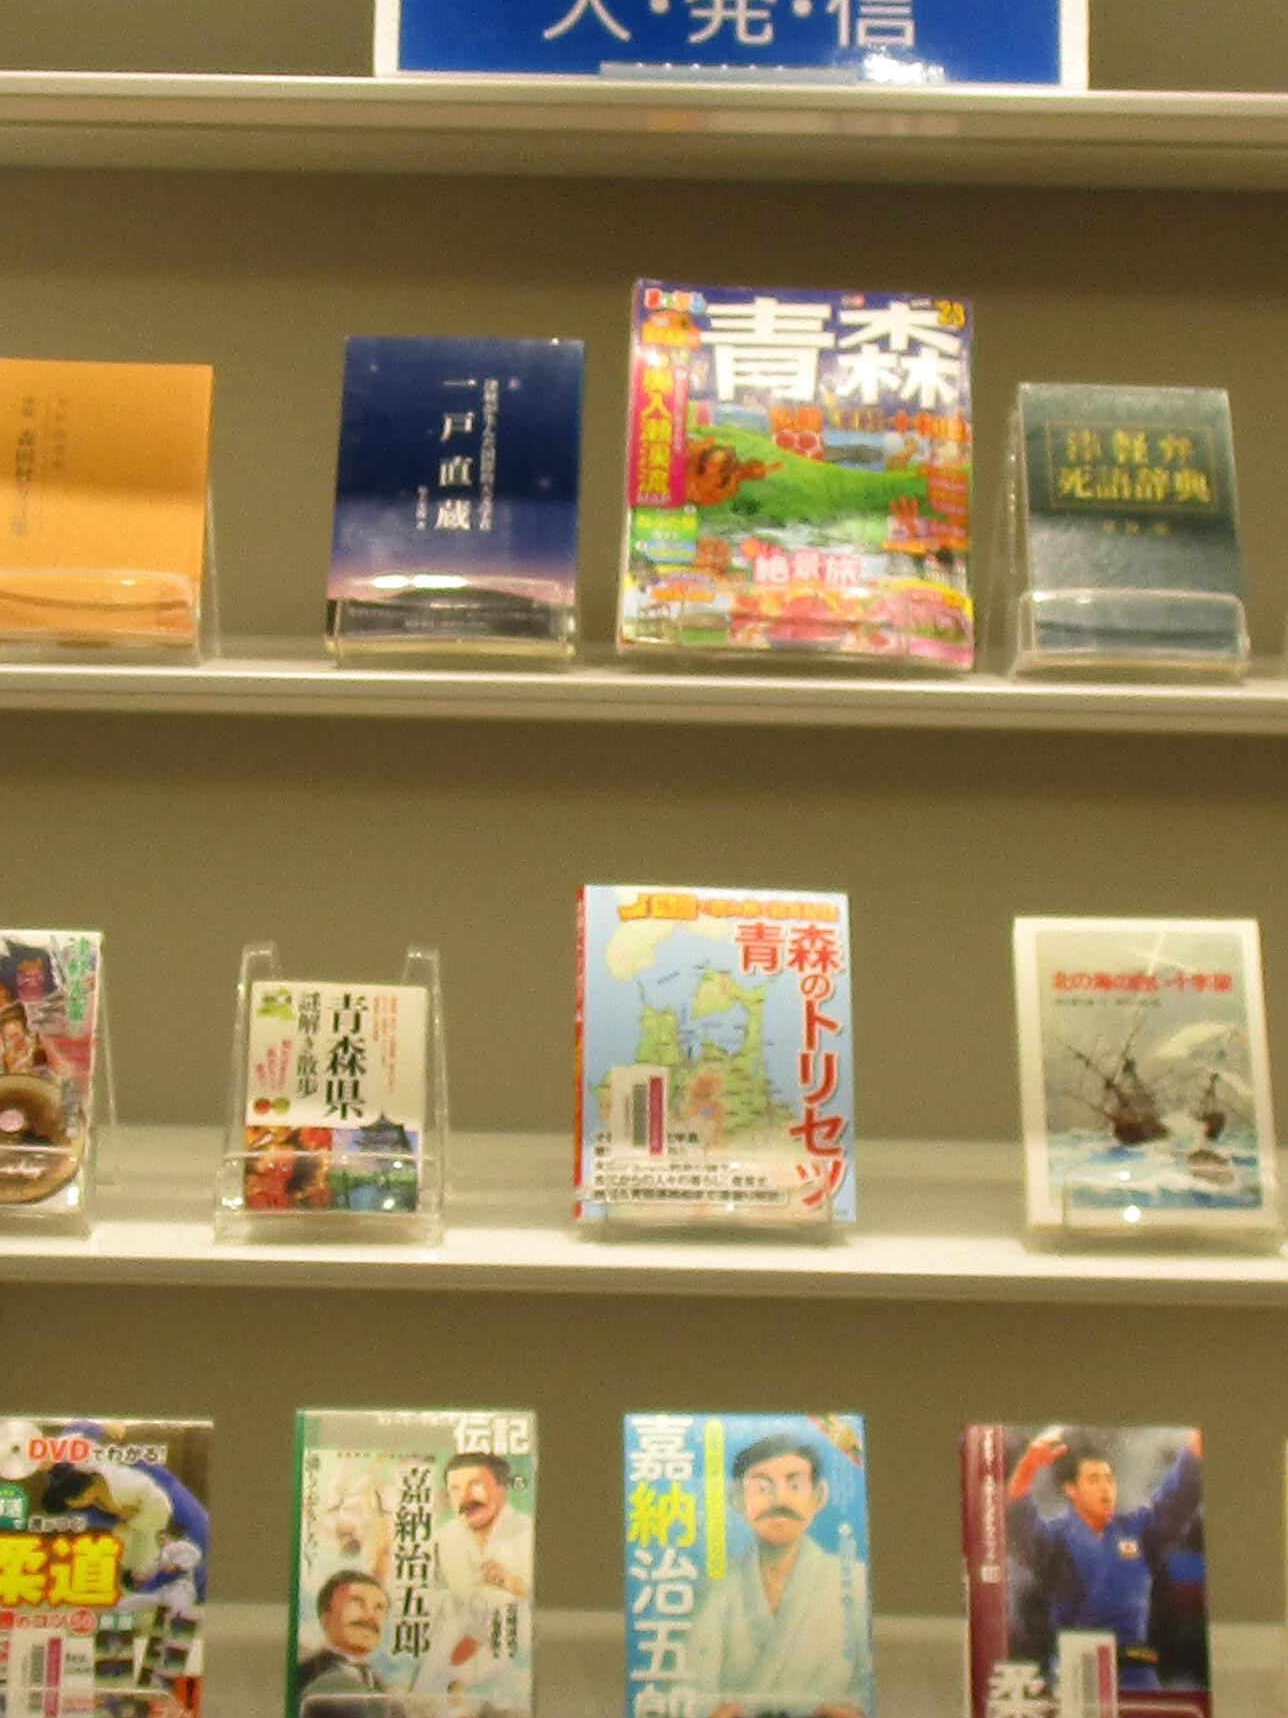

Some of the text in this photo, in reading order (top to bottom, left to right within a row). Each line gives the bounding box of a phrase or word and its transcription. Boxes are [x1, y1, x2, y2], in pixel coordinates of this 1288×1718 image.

[699, 296, 967, 410] 青森
[324, 992, 368, 1121] 青森県
[452, 1416, 530, 1456] 伝記
[393, 1463, 434, 1660] 嘉納治五郎
